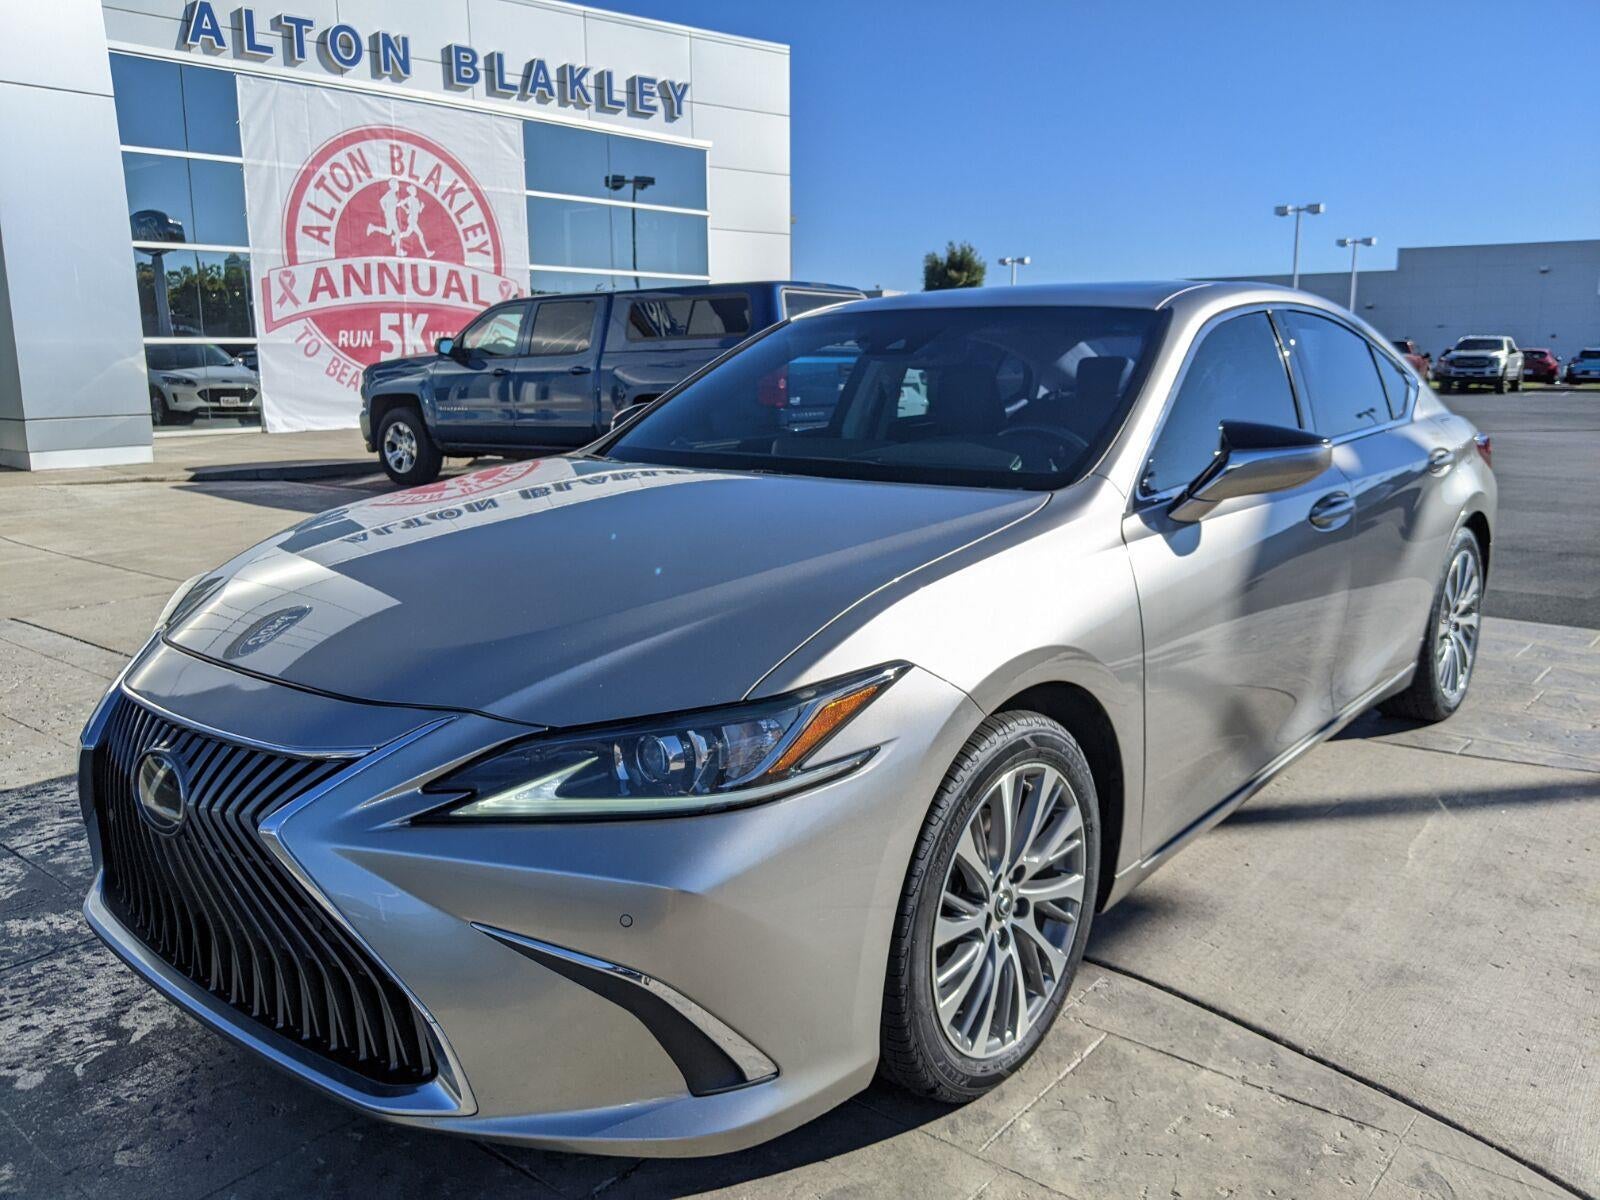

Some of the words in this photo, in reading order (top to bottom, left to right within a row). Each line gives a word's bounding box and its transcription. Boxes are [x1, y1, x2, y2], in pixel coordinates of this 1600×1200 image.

[185, 0, 411, 79] ALTON
[444, 42, 692, 122] BLAKLEY
[302, 147, 373, 246] ALTON
[389, 143, 491, 257] BLAKLEY
[308, 262, 492, 308] ANNUAL
[295, 325, 321, 358] TO
[325, 356, 361, 393] BEA
[338, 330, 374, 348] RUN
[379, 312, 429, 361] 5K
